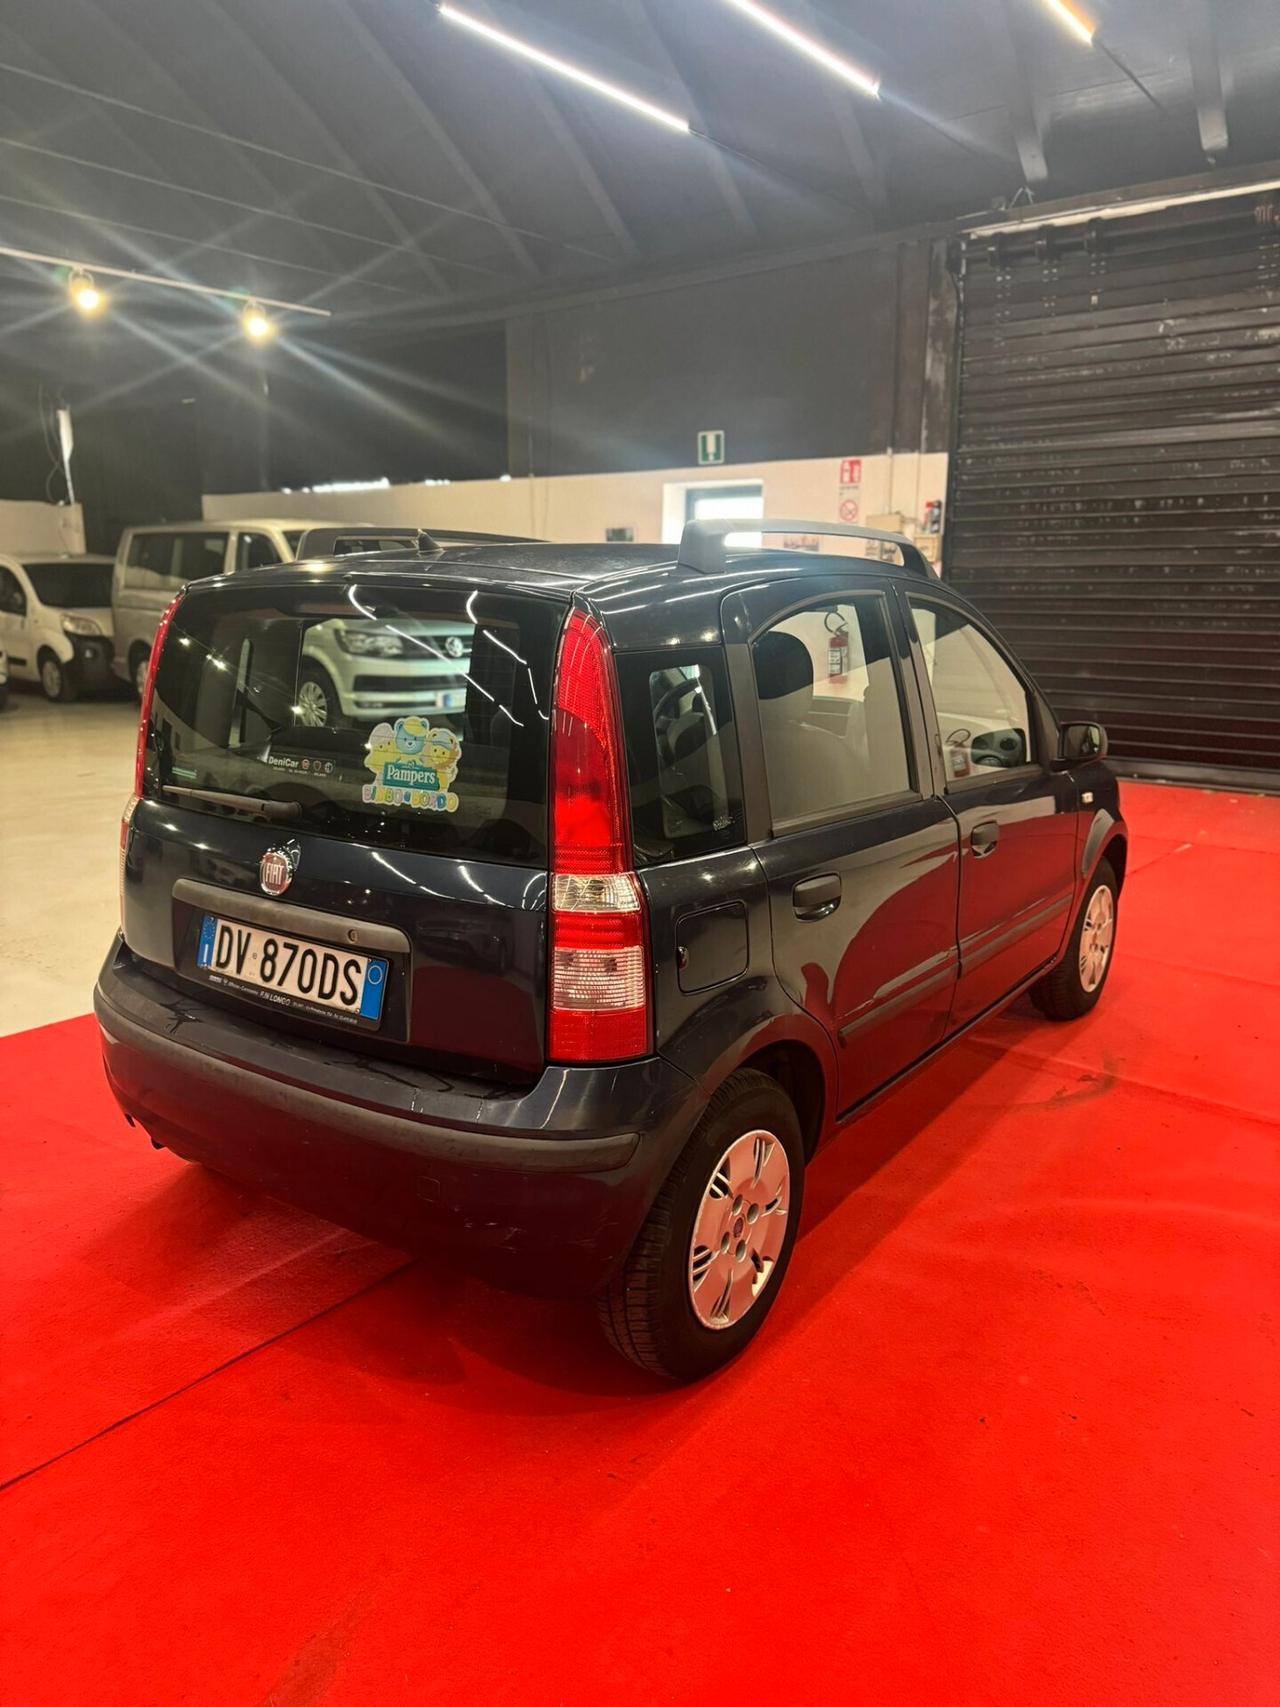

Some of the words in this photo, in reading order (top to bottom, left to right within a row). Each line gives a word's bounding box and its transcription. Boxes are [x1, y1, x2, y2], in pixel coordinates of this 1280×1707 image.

[268, 756, 299, 768] DeniCar
[387, 764, 436, 786] Pampers
[265, 862, 285, 885] FIAT
[215, 924, 252, 975] DV
[260, 938, 362, 1006] 870DS
[269, 994, 291, 1006] LONGO
